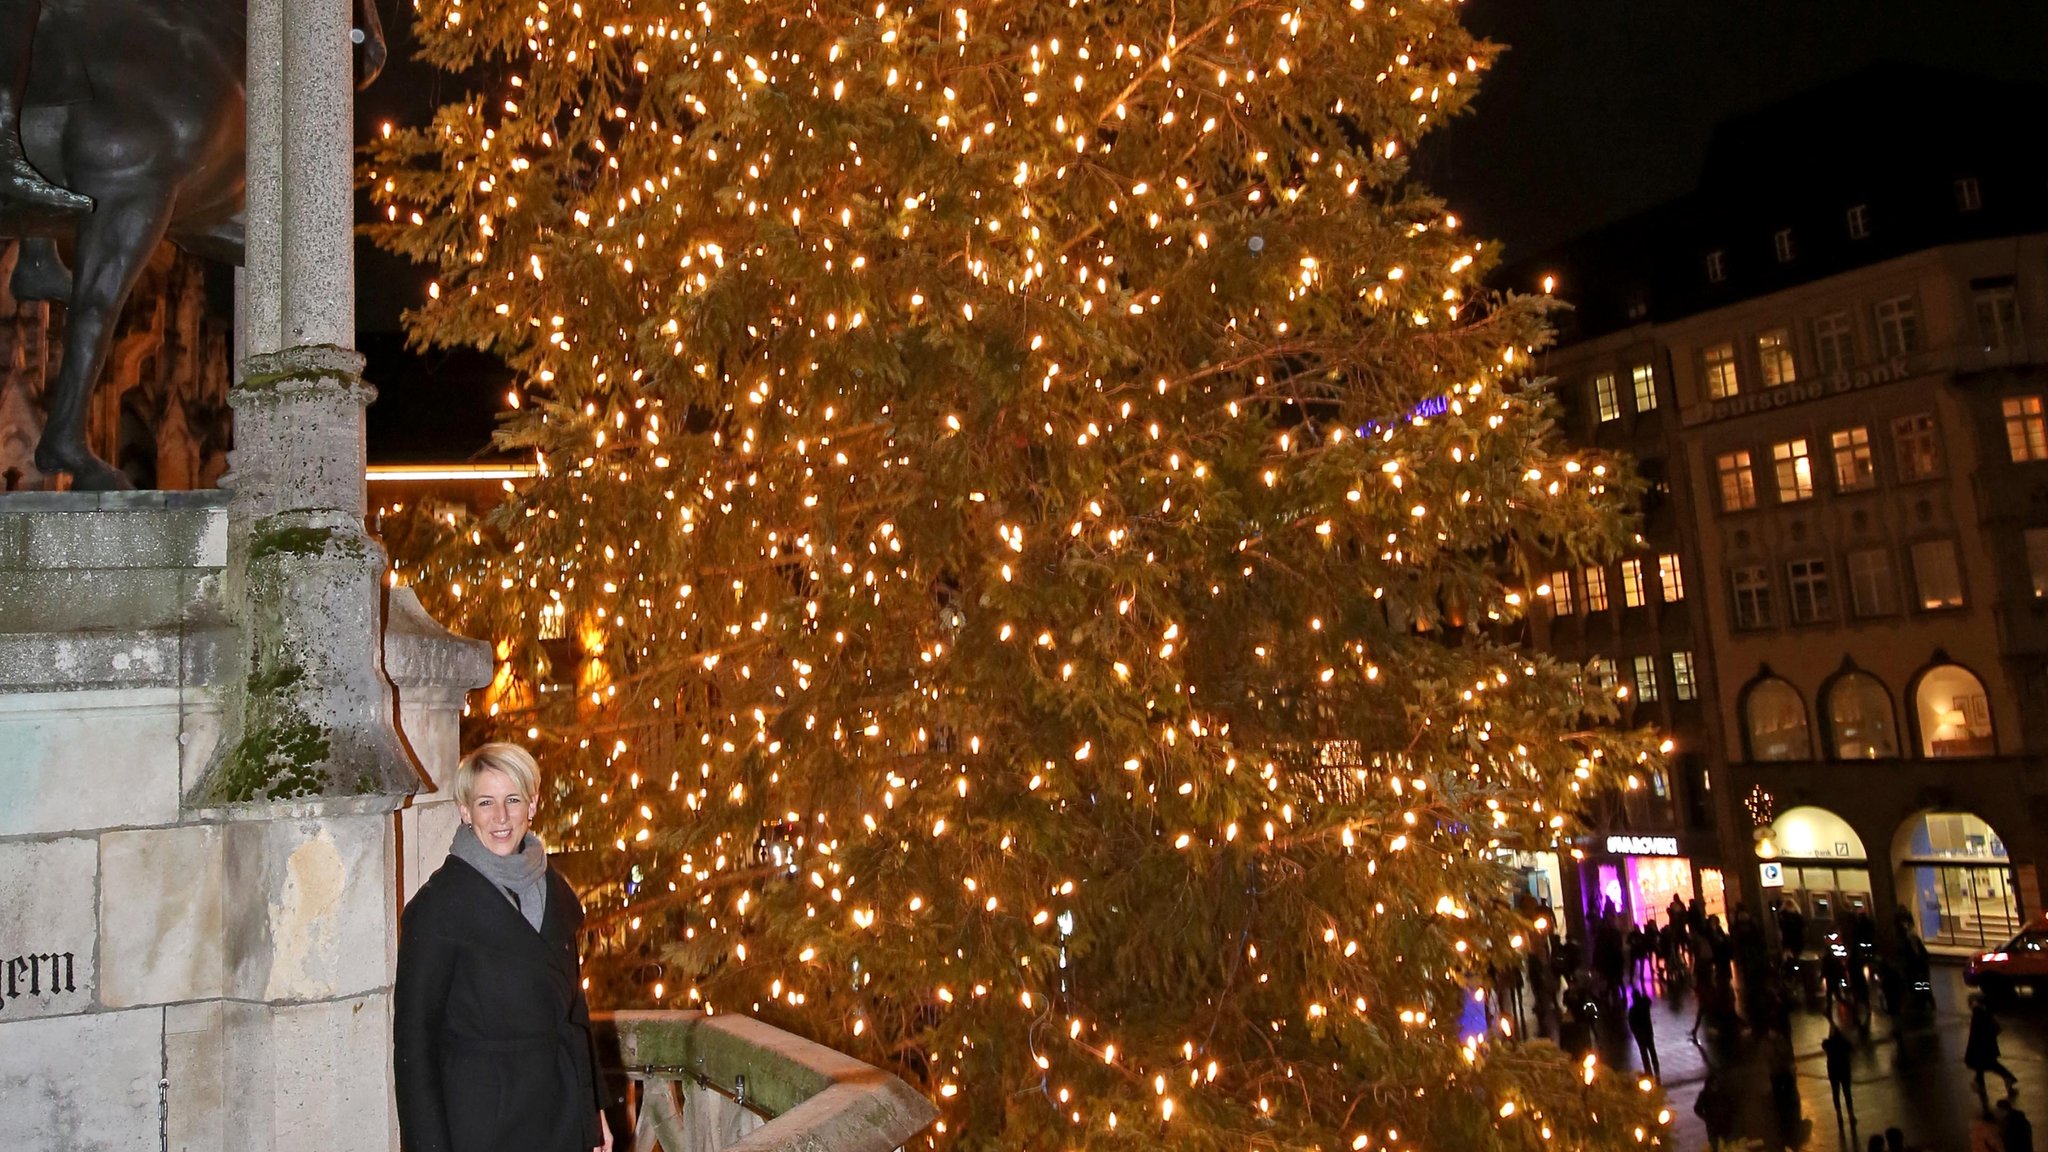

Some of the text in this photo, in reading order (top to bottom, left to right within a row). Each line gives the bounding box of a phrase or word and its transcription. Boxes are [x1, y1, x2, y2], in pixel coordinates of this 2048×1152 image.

[1697, 360, 1909, 421] Deutsche Bank
[1780, 847, 1812, 857] Dehe
[0, 952, 77, 1010] ern
